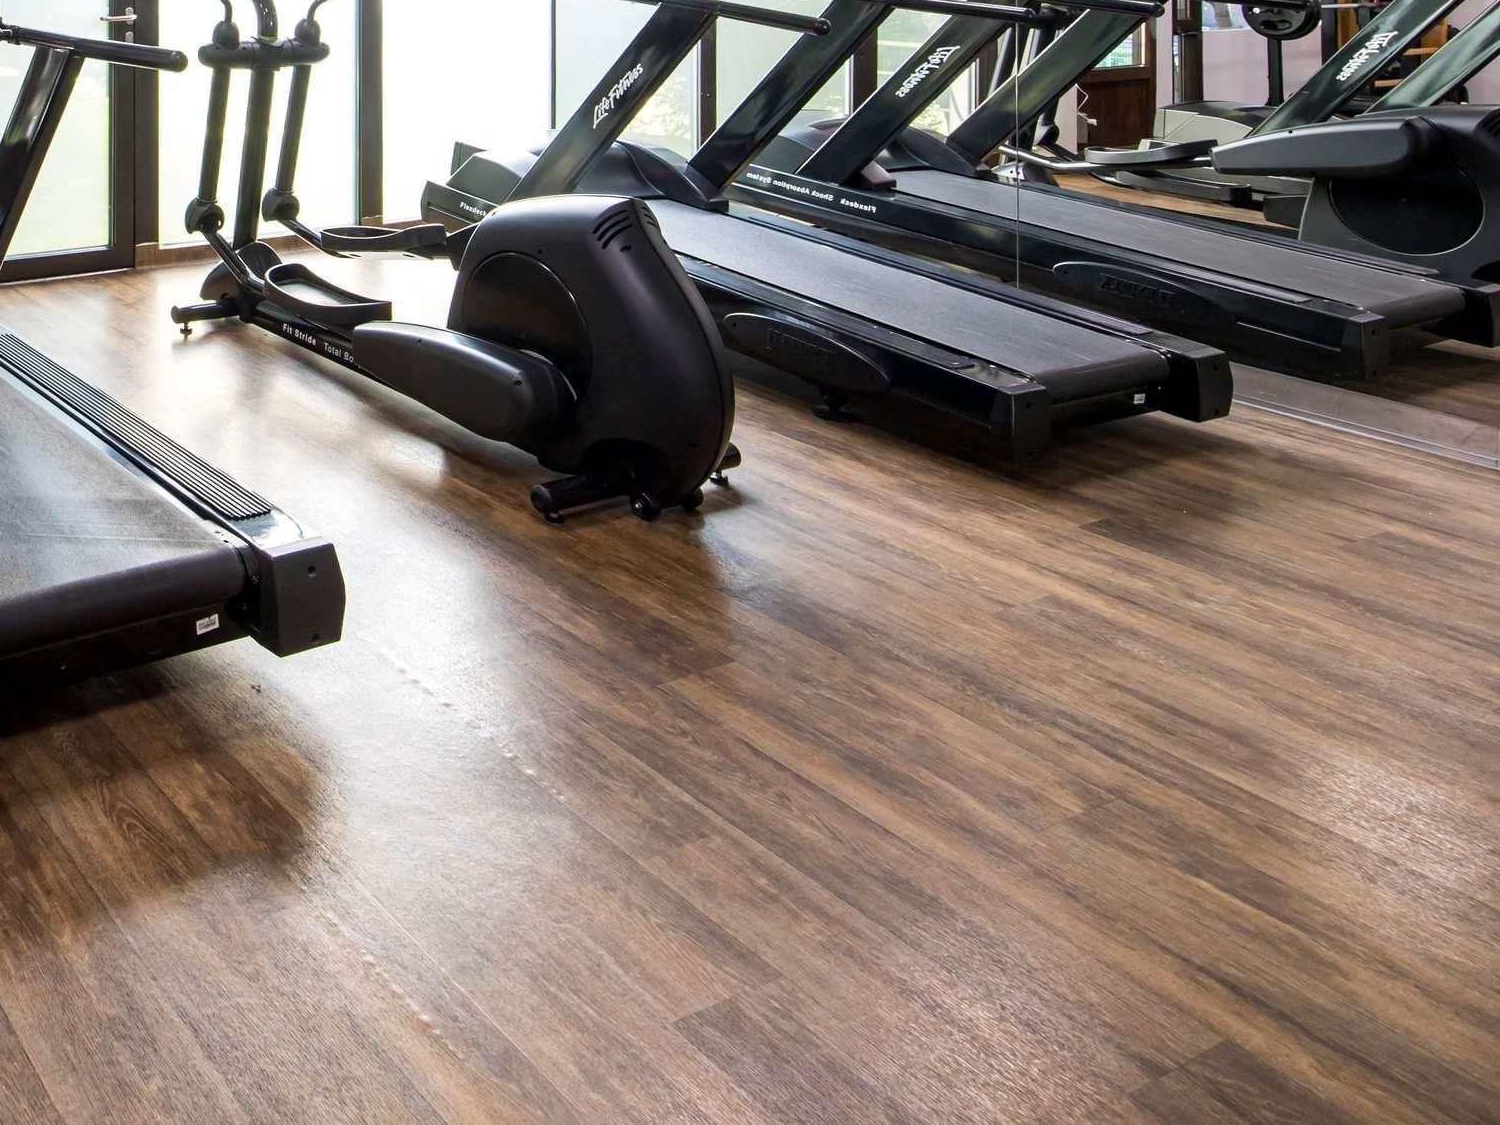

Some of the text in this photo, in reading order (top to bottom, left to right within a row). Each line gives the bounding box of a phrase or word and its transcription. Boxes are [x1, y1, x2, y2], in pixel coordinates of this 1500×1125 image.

[282, 323, 355, 363] Fit Stride Total Bo
